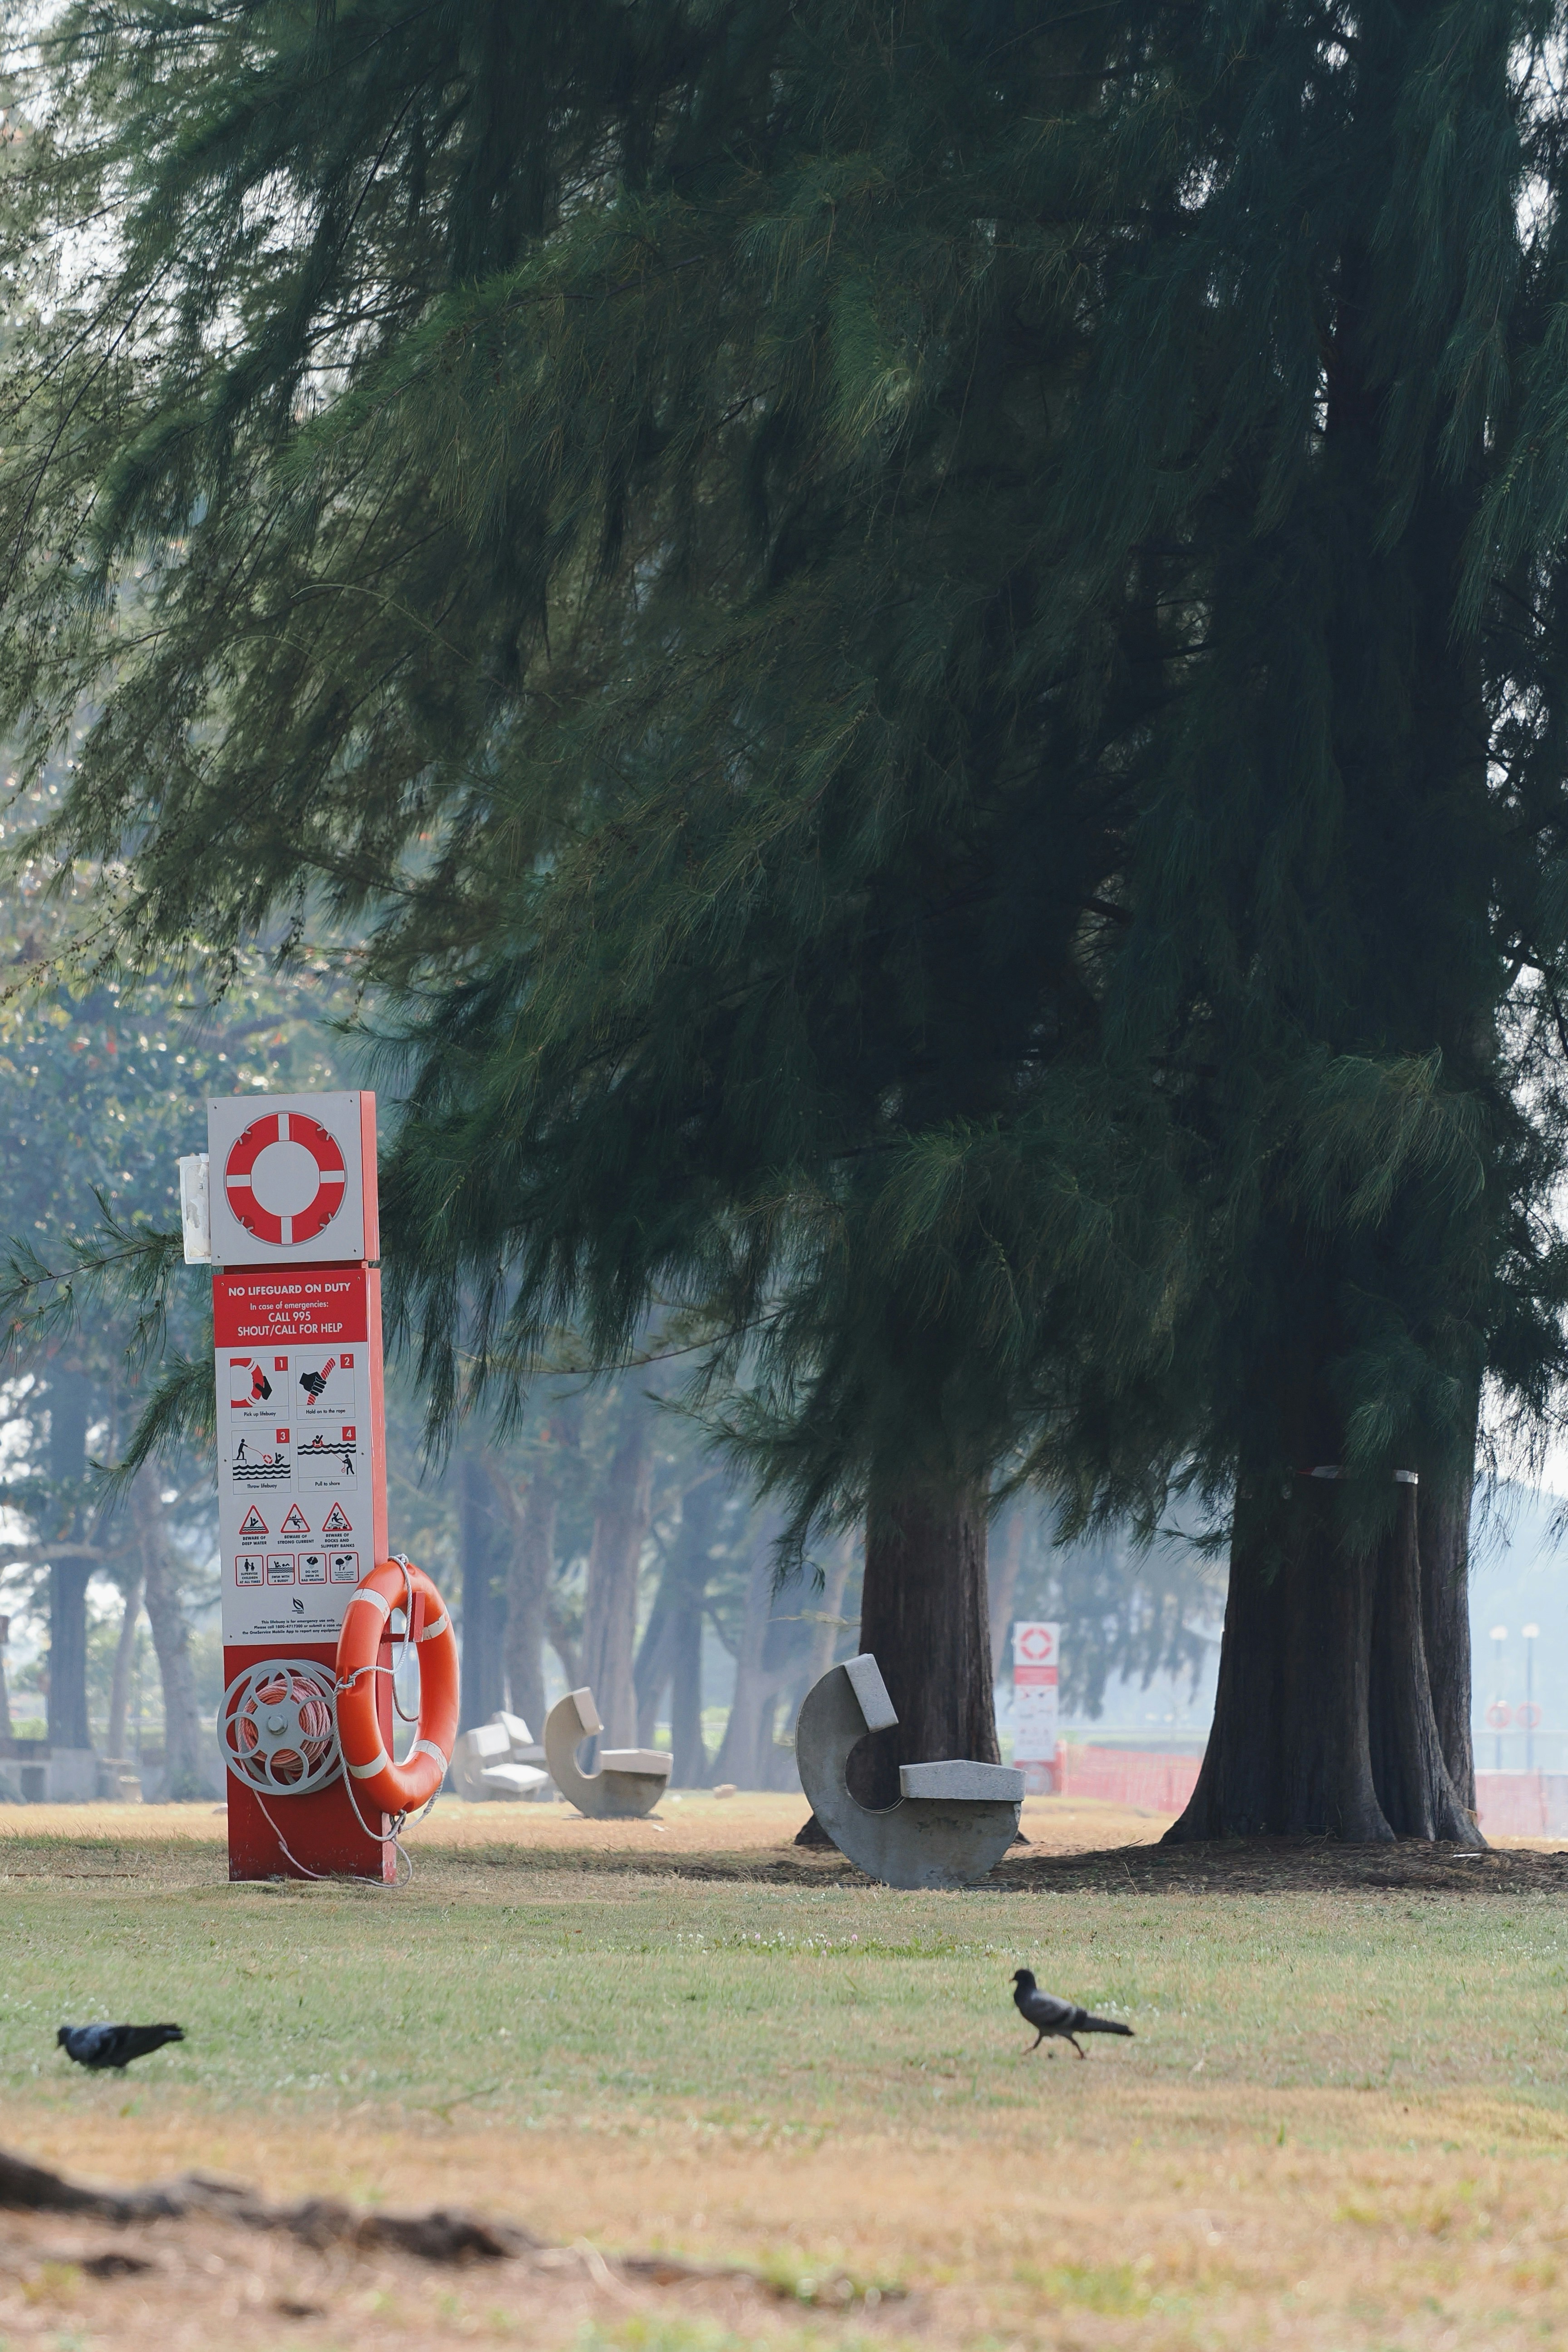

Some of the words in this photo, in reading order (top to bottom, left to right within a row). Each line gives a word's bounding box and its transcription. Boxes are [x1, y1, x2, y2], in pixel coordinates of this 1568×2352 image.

[228, 1287, 245, 1296] NO
[248, 1285, 302, 1295] LIFEGUARD
[304, 1284, 321, 1293] ON
[325, 1283, 351, 1292] DUTY
[275, 1301, 283, 1309] of
[284, 1300, 328, 1310] emergencies:
[268, 1312, 290, 1322] CALL
[293, 1311, 311, 1321] 995
[238, 1325, 297, 1337] SHOUT/CALL
[299, 1324, 318, 1333] FOR
[321, 1323, 343, 1333] HELP
[279, 1360, 283, 1368] 1
[344, 1357, 350, 1366] 2
[280, 1432, 286, 1440] 3
[346, 1430, 352, 1438] 4
